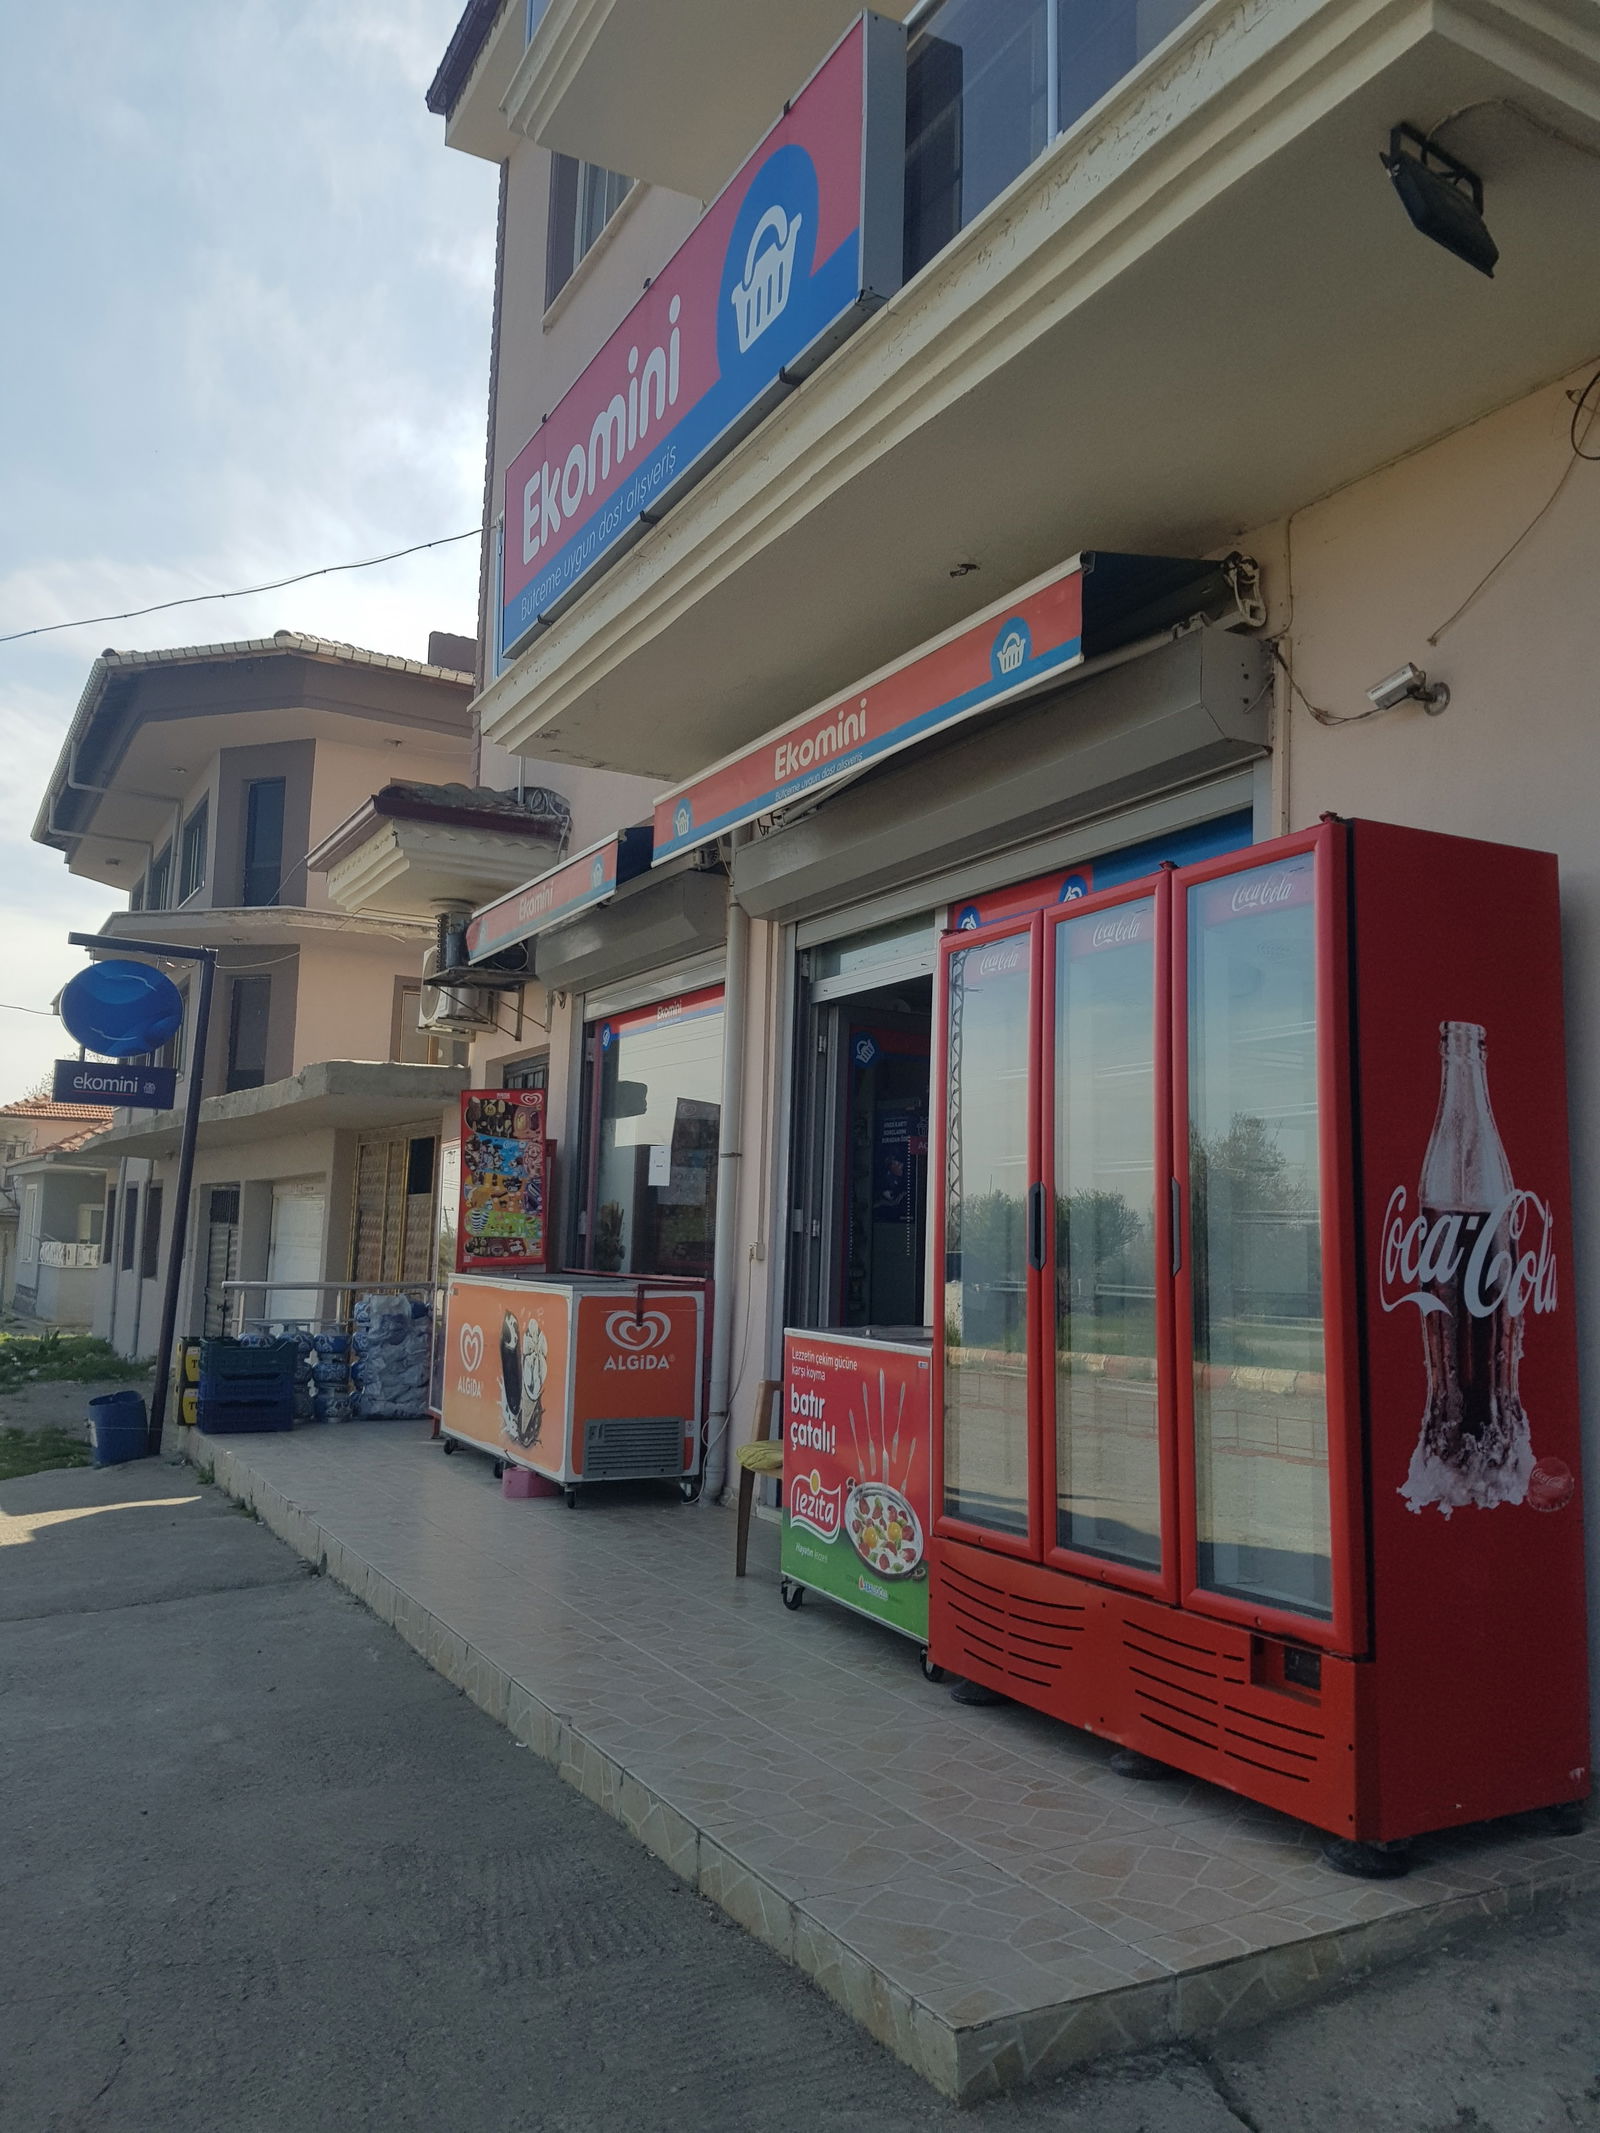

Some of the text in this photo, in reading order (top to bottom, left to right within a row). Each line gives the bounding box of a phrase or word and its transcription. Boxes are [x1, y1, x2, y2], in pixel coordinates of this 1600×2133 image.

[523, 294, 681, 565] Ekomini
[564, 531, 596, 578] uygun
[598, 501, 624, 541] dost
[626, 445, 677, 513] alışveriş
[774, 697, 868, 781] Ekomini
[519, 881, 554, 920] Ekomini
[73, 1072, 138, 1093] ekomini
[1379, 1185, 1558, 1318] Coca-Cola
[791, 1347, 858, 1371] Lezzetin çekim gücüne
[791, 1363, 826, 1381] karşı koyma
[790, 1383, 826, 1419] batır
[790, 1420, 836, 1455] çatalı!
